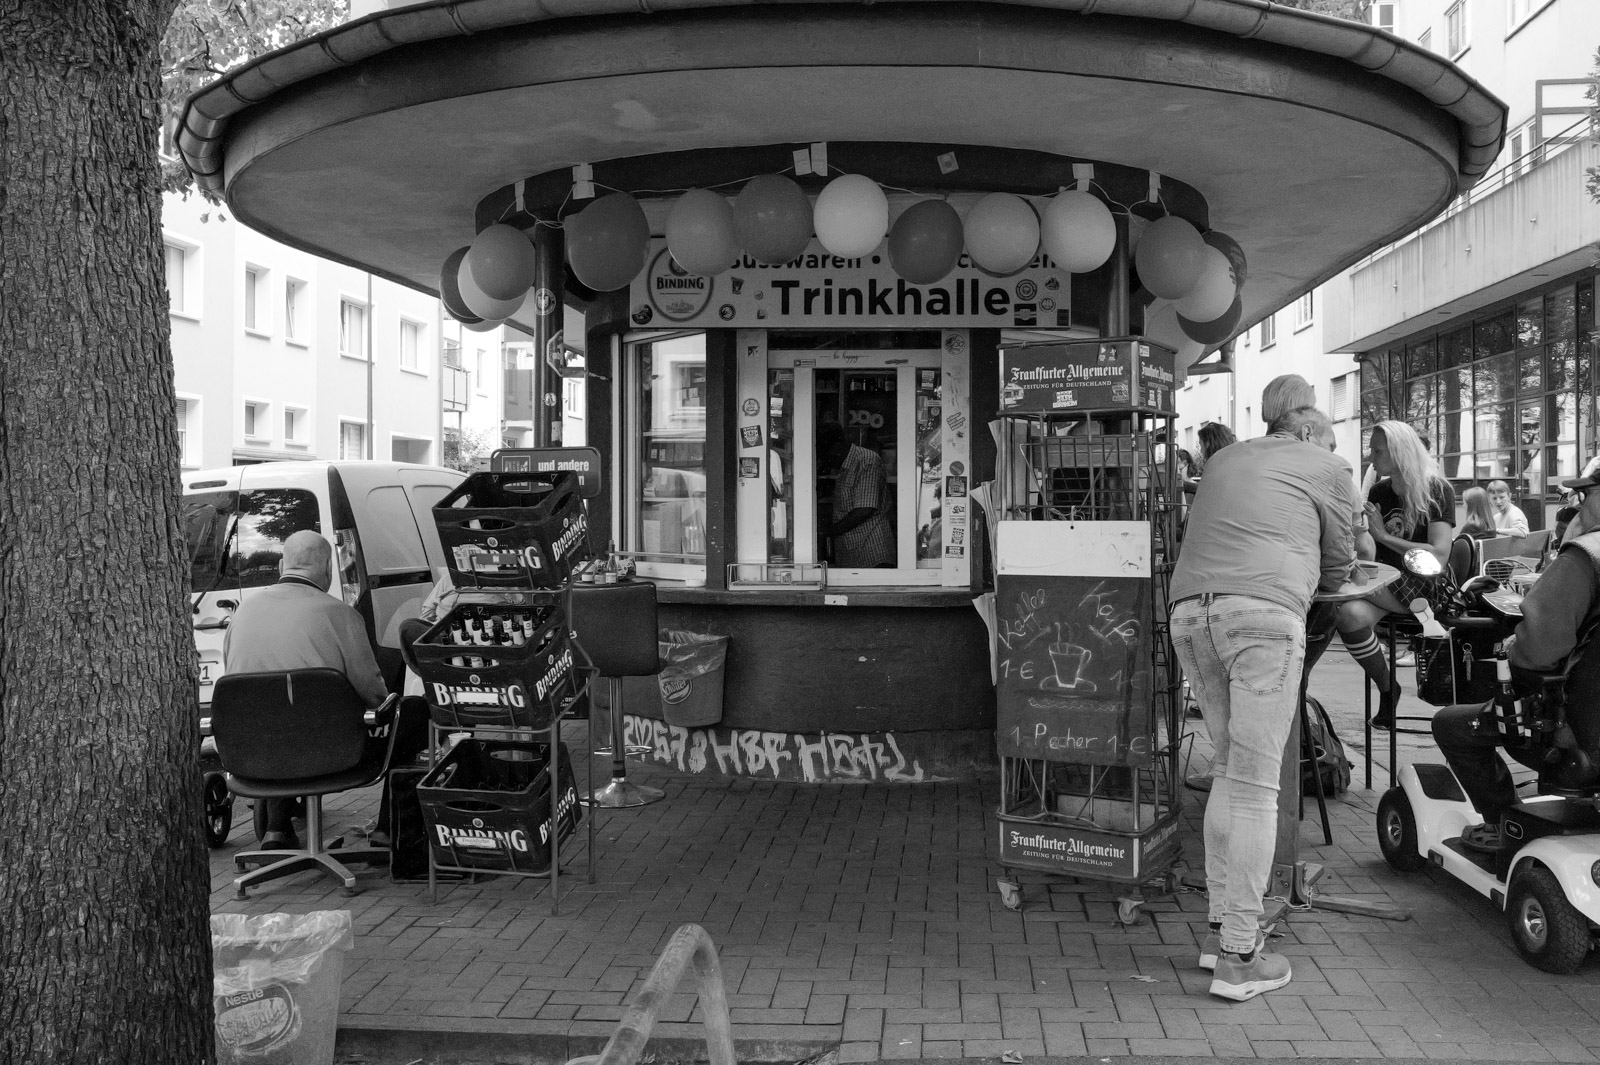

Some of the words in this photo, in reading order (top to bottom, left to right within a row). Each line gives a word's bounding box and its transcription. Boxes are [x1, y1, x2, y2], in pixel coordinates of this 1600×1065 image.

[656, 276, 704, 290] BINDING
[771, 278, 1010, 315] Trinkhalle
[1010, 366, 1067, 383] Frankfurter
[1066, 363, 1124, 381] Allgemeine
[1066, 380, 1112, 388] DEUTSCHLAND
[538, 459, 555, 472] und
[557, 459, 590, 472] andere
[551, 513, 588, 562] BINDING
[535, 648, 573, 701] BINDING
[1010, 830, 1067, 852] Frankfurter
[1066, 837, 1125, 859] Allgemeine
[1022, 849, 1050, 859] ZEITUNG
[1051, 852, 1065, 861] FÜR
[1066, 856, 1113, 867] DEUTSCHLAND
